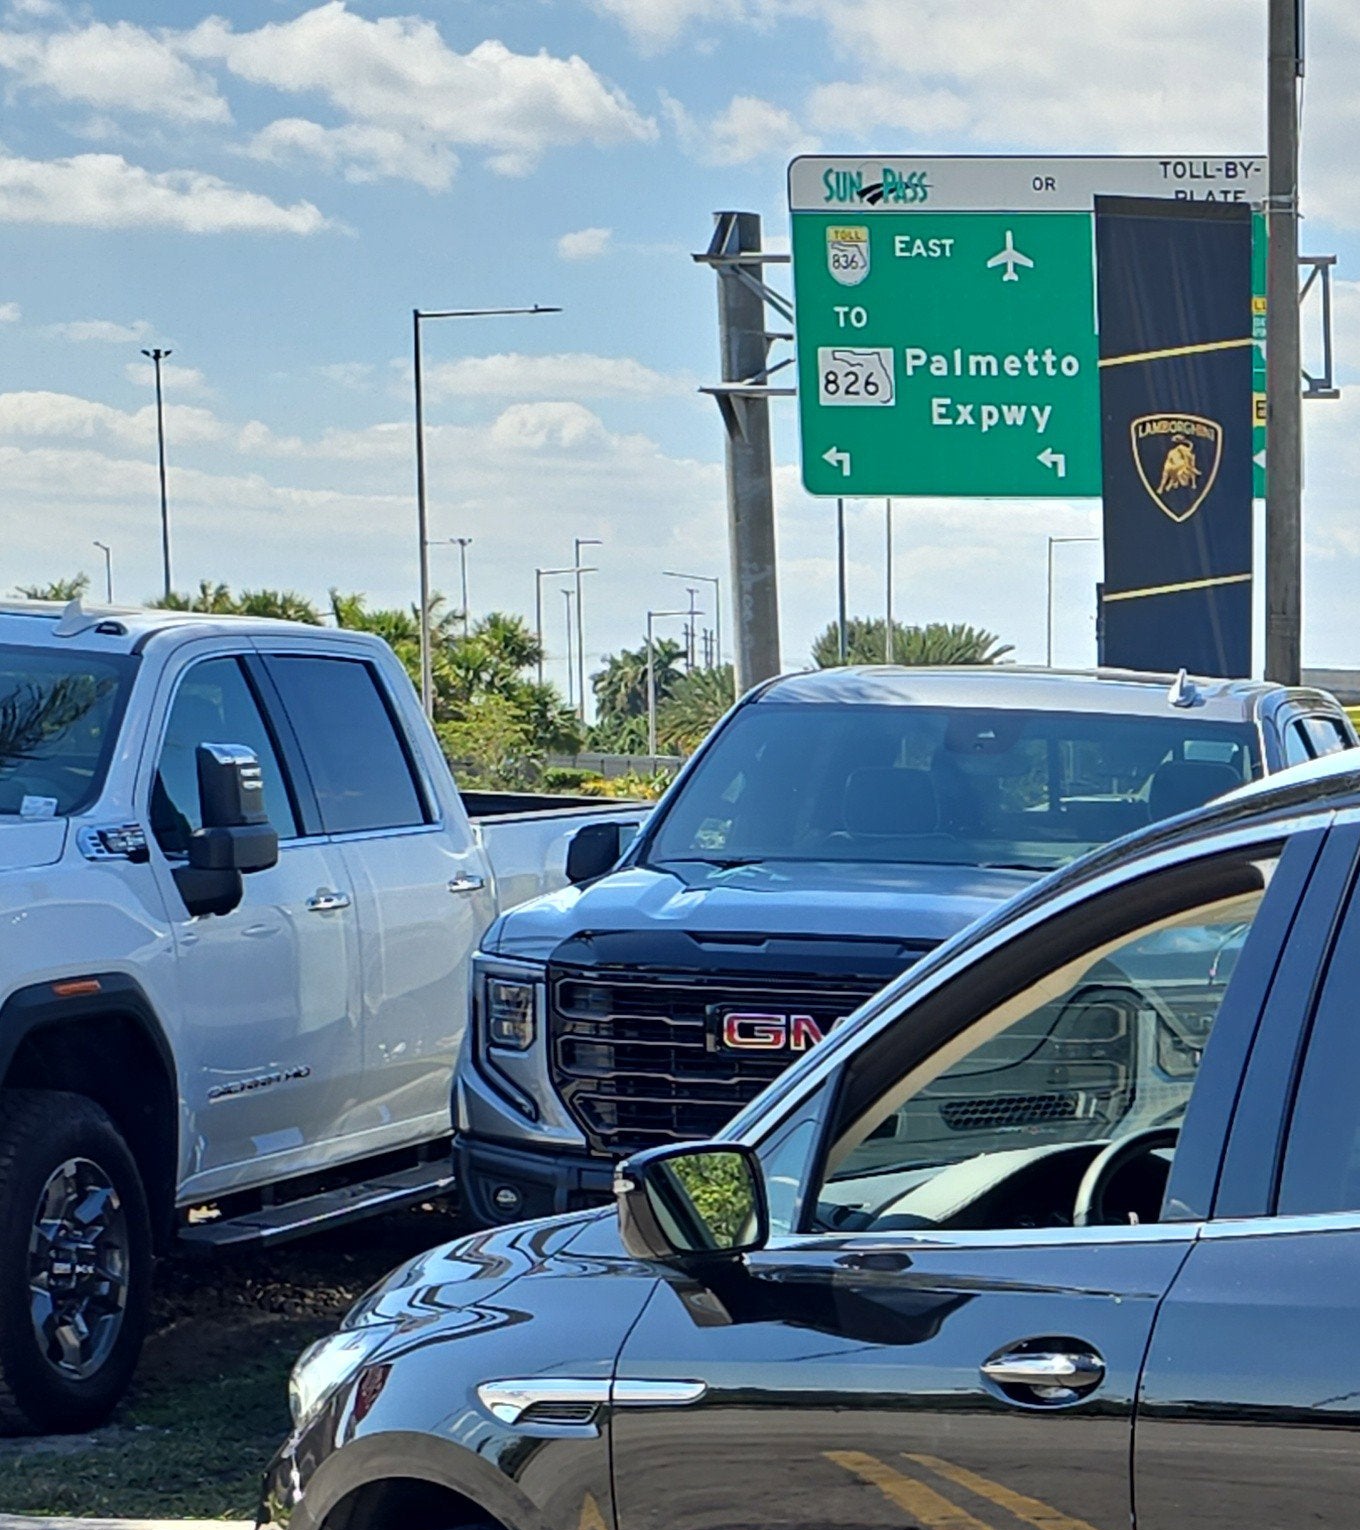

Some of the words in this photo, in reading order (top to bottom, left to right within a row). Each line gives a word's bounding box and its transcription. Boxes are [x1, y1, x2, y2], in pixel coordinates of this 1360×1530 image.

[1159, 161, 1262, 179] TOLL-BY-
[1032, 177, 1057, 192] OR
[834, 229, 861, 240] TOLL
[894, 235, 955, 258] EAST
[832, 253, 860, 270] 836
[833, 305, 868, 328] TO
[824, 370, 880, 396] 826
[905, 347, 1080, 377] Palmetto
[931, 396, 1052, 433] Expwy
[1137, 419, 1215, 443] LAMBORGHINI
[723, 1013, 849, 1050] GM
